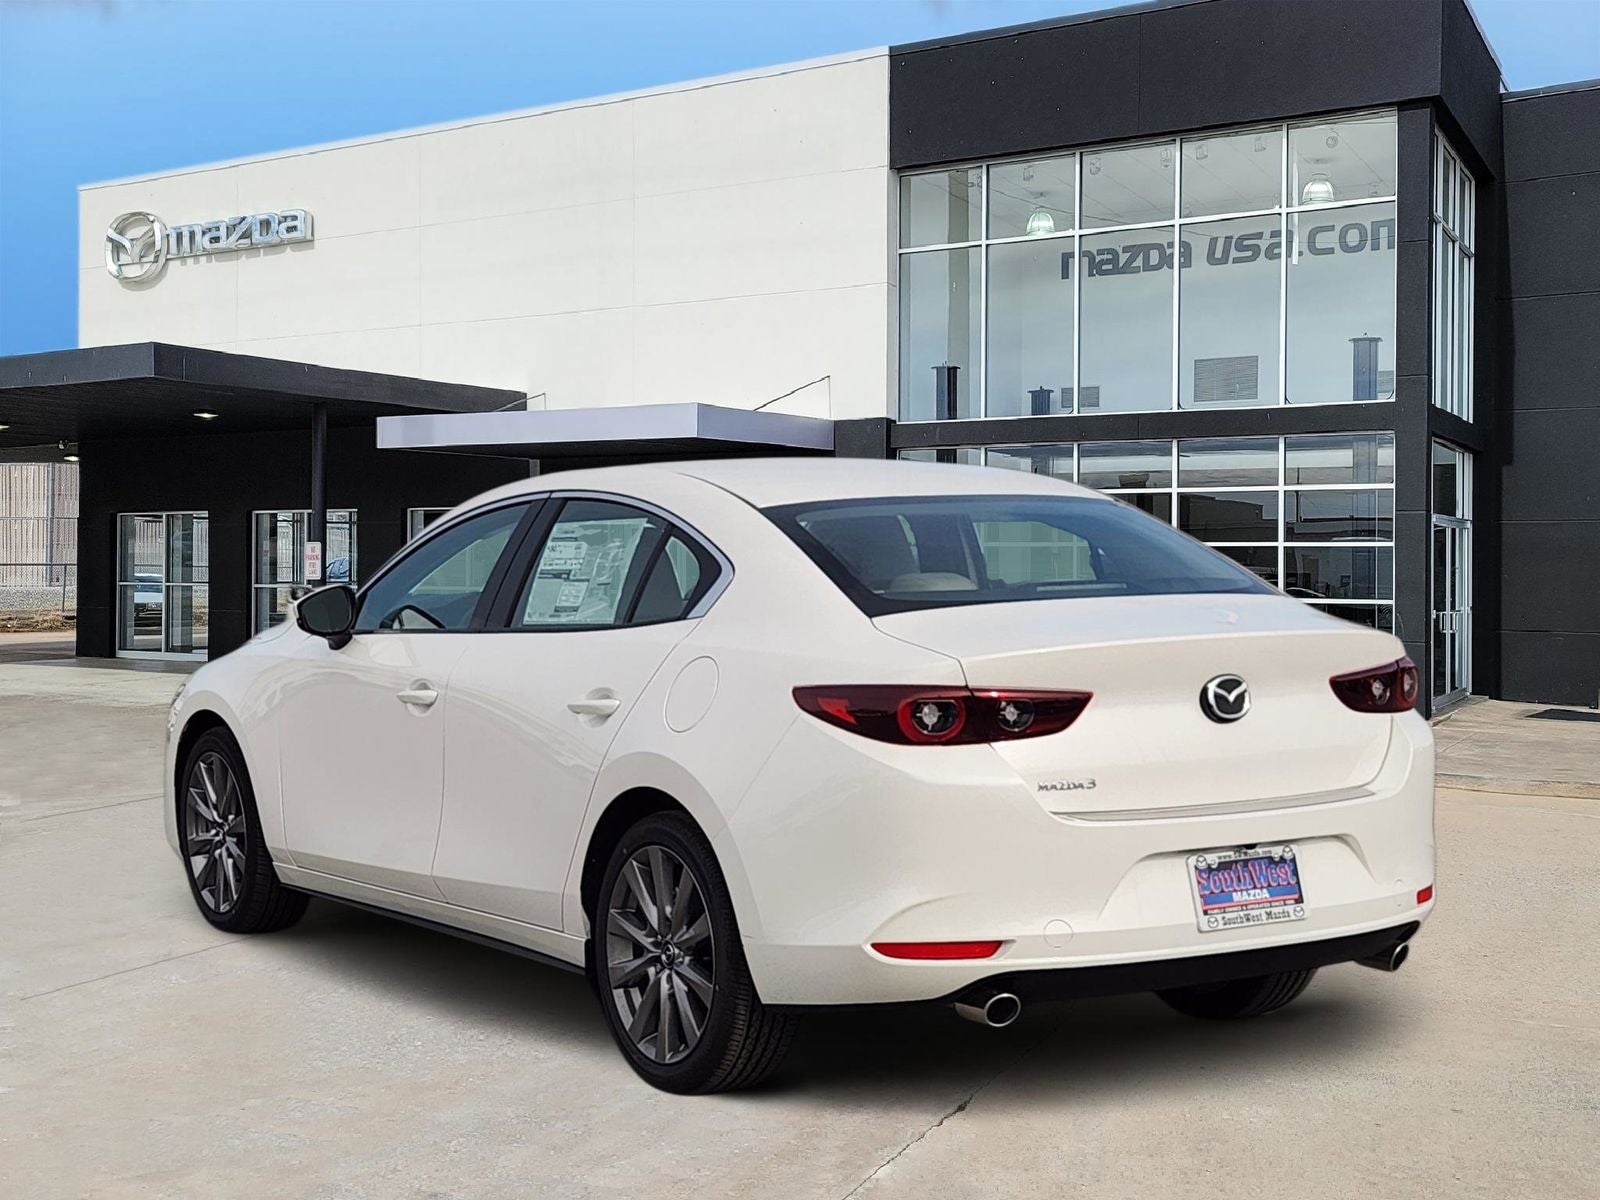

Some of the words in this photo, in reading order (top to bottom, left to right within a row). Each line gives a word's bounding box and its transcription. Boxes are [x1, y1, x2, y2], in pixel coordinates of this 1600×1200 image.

[166, 209, 310, 255] mazda
[1061, 241, 1192, 280] mazda
[1196, 860, 1297, 895] SouthWest
[1232, 888, 1270, 902] MAZDA
[1221, 911, 1262, 926] SouthWest
[1265, 909, 1291, 920] Mazda
